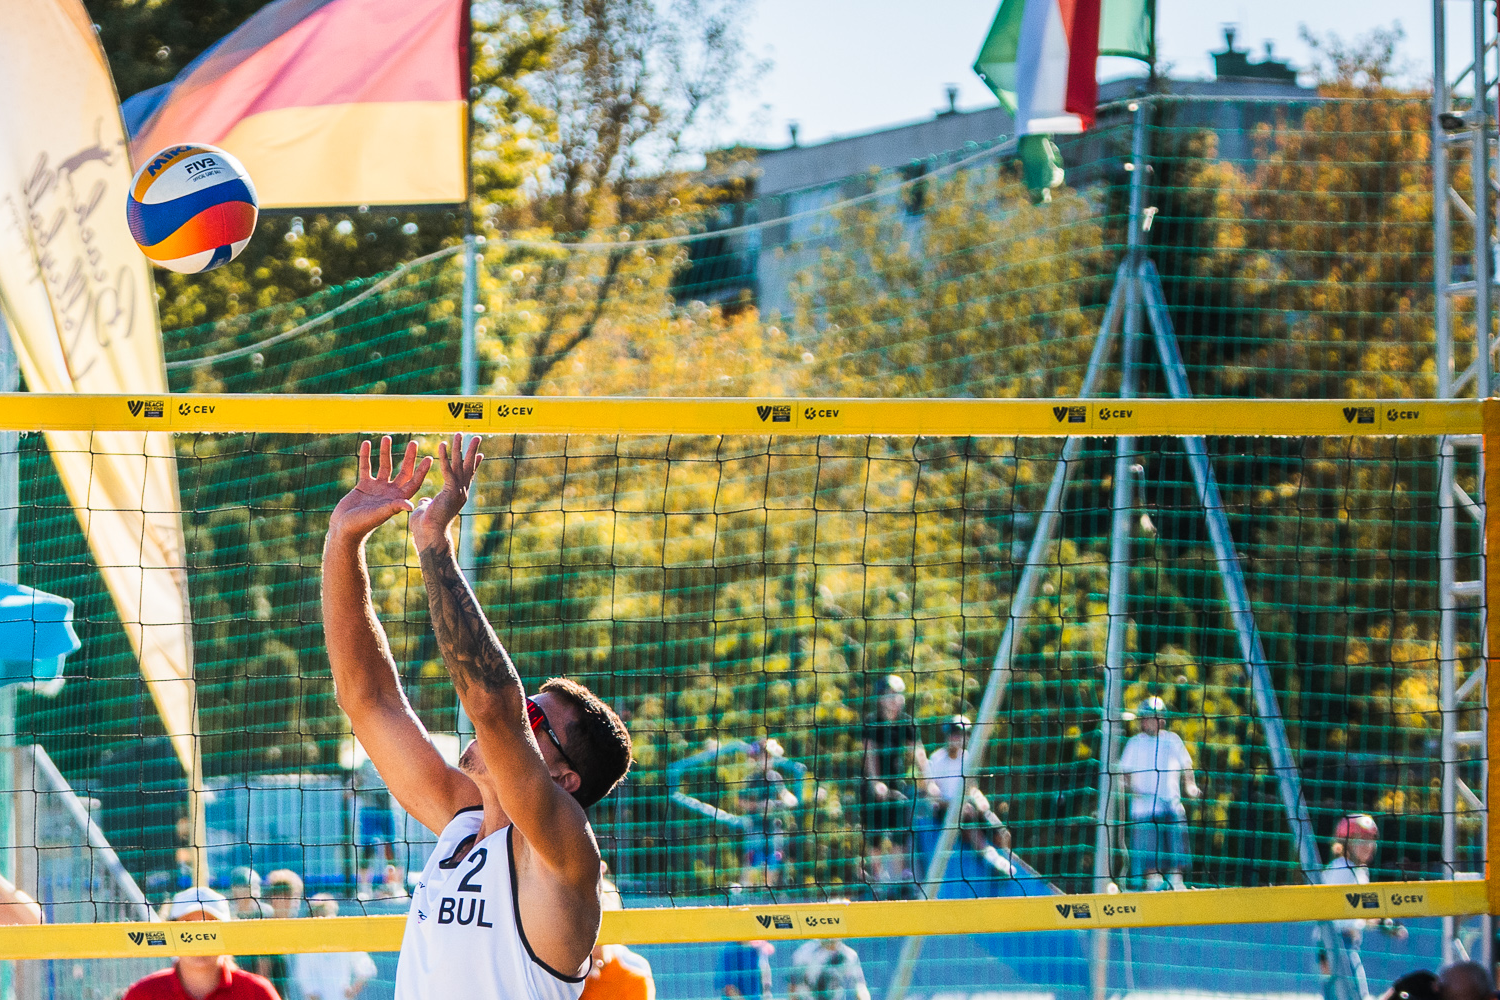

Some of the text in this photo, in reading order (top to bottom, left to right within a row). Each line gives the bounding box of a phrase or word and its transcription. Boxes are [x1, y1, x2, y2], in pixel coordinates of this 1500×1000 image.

[184, 157, 216, 174] FIVB
[194, 405, 216, 413] CEV
[512, 407, 533, 415] CEV
[819, 410, 840, 418] CEV
[1113, 410, 1133, 418] CEV
[1400, 411, 1420, 419] CEV
[457, 847, 488, 892] 2
[1404, 895, 1423, 903] CEV
[438, 897, 493, 928] BUL
[1117, 905, 1136, 913] CEV
[820, 917, 840, 925] CEV
[196, 933, 217, 941] CEV
